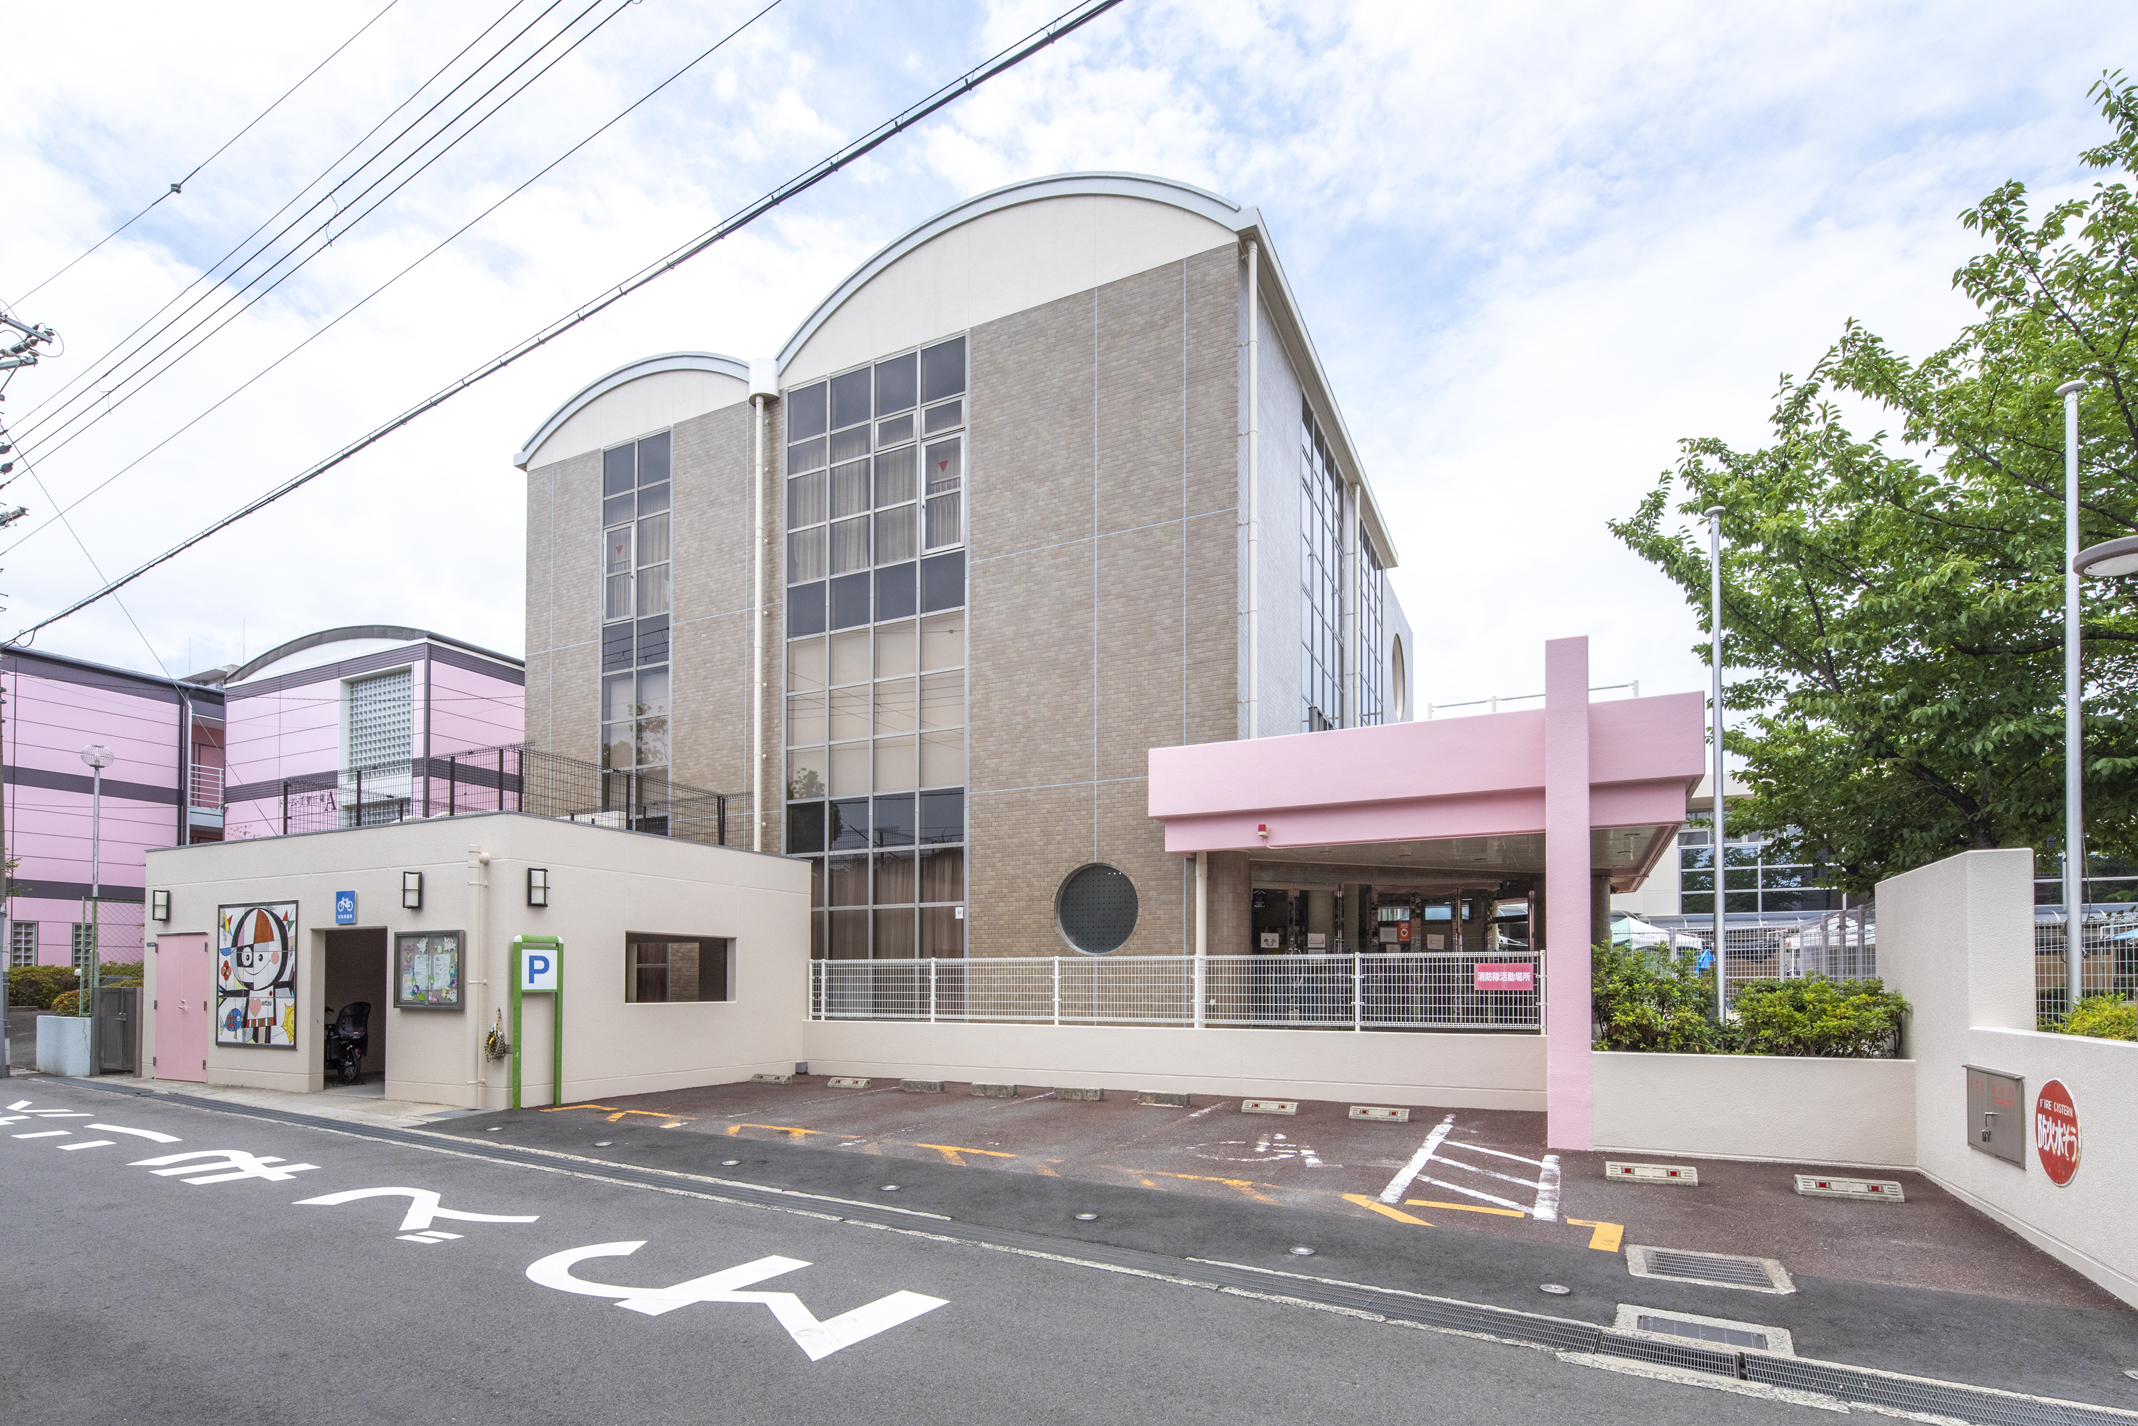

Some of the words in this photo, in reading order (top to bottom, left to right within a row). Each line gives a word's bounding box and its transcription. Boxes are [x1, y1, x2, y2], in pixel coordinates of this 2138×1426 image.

[528, 955, 550, 984] P
[1477, 971, 1531, 982] 消防隊活動場所
[2039, 1098, 2052, 1111] FIRE
[2053, 1101, 2074, 1118] CISTERN
[2037, 1113, 2077, 1163] 防火水そう
